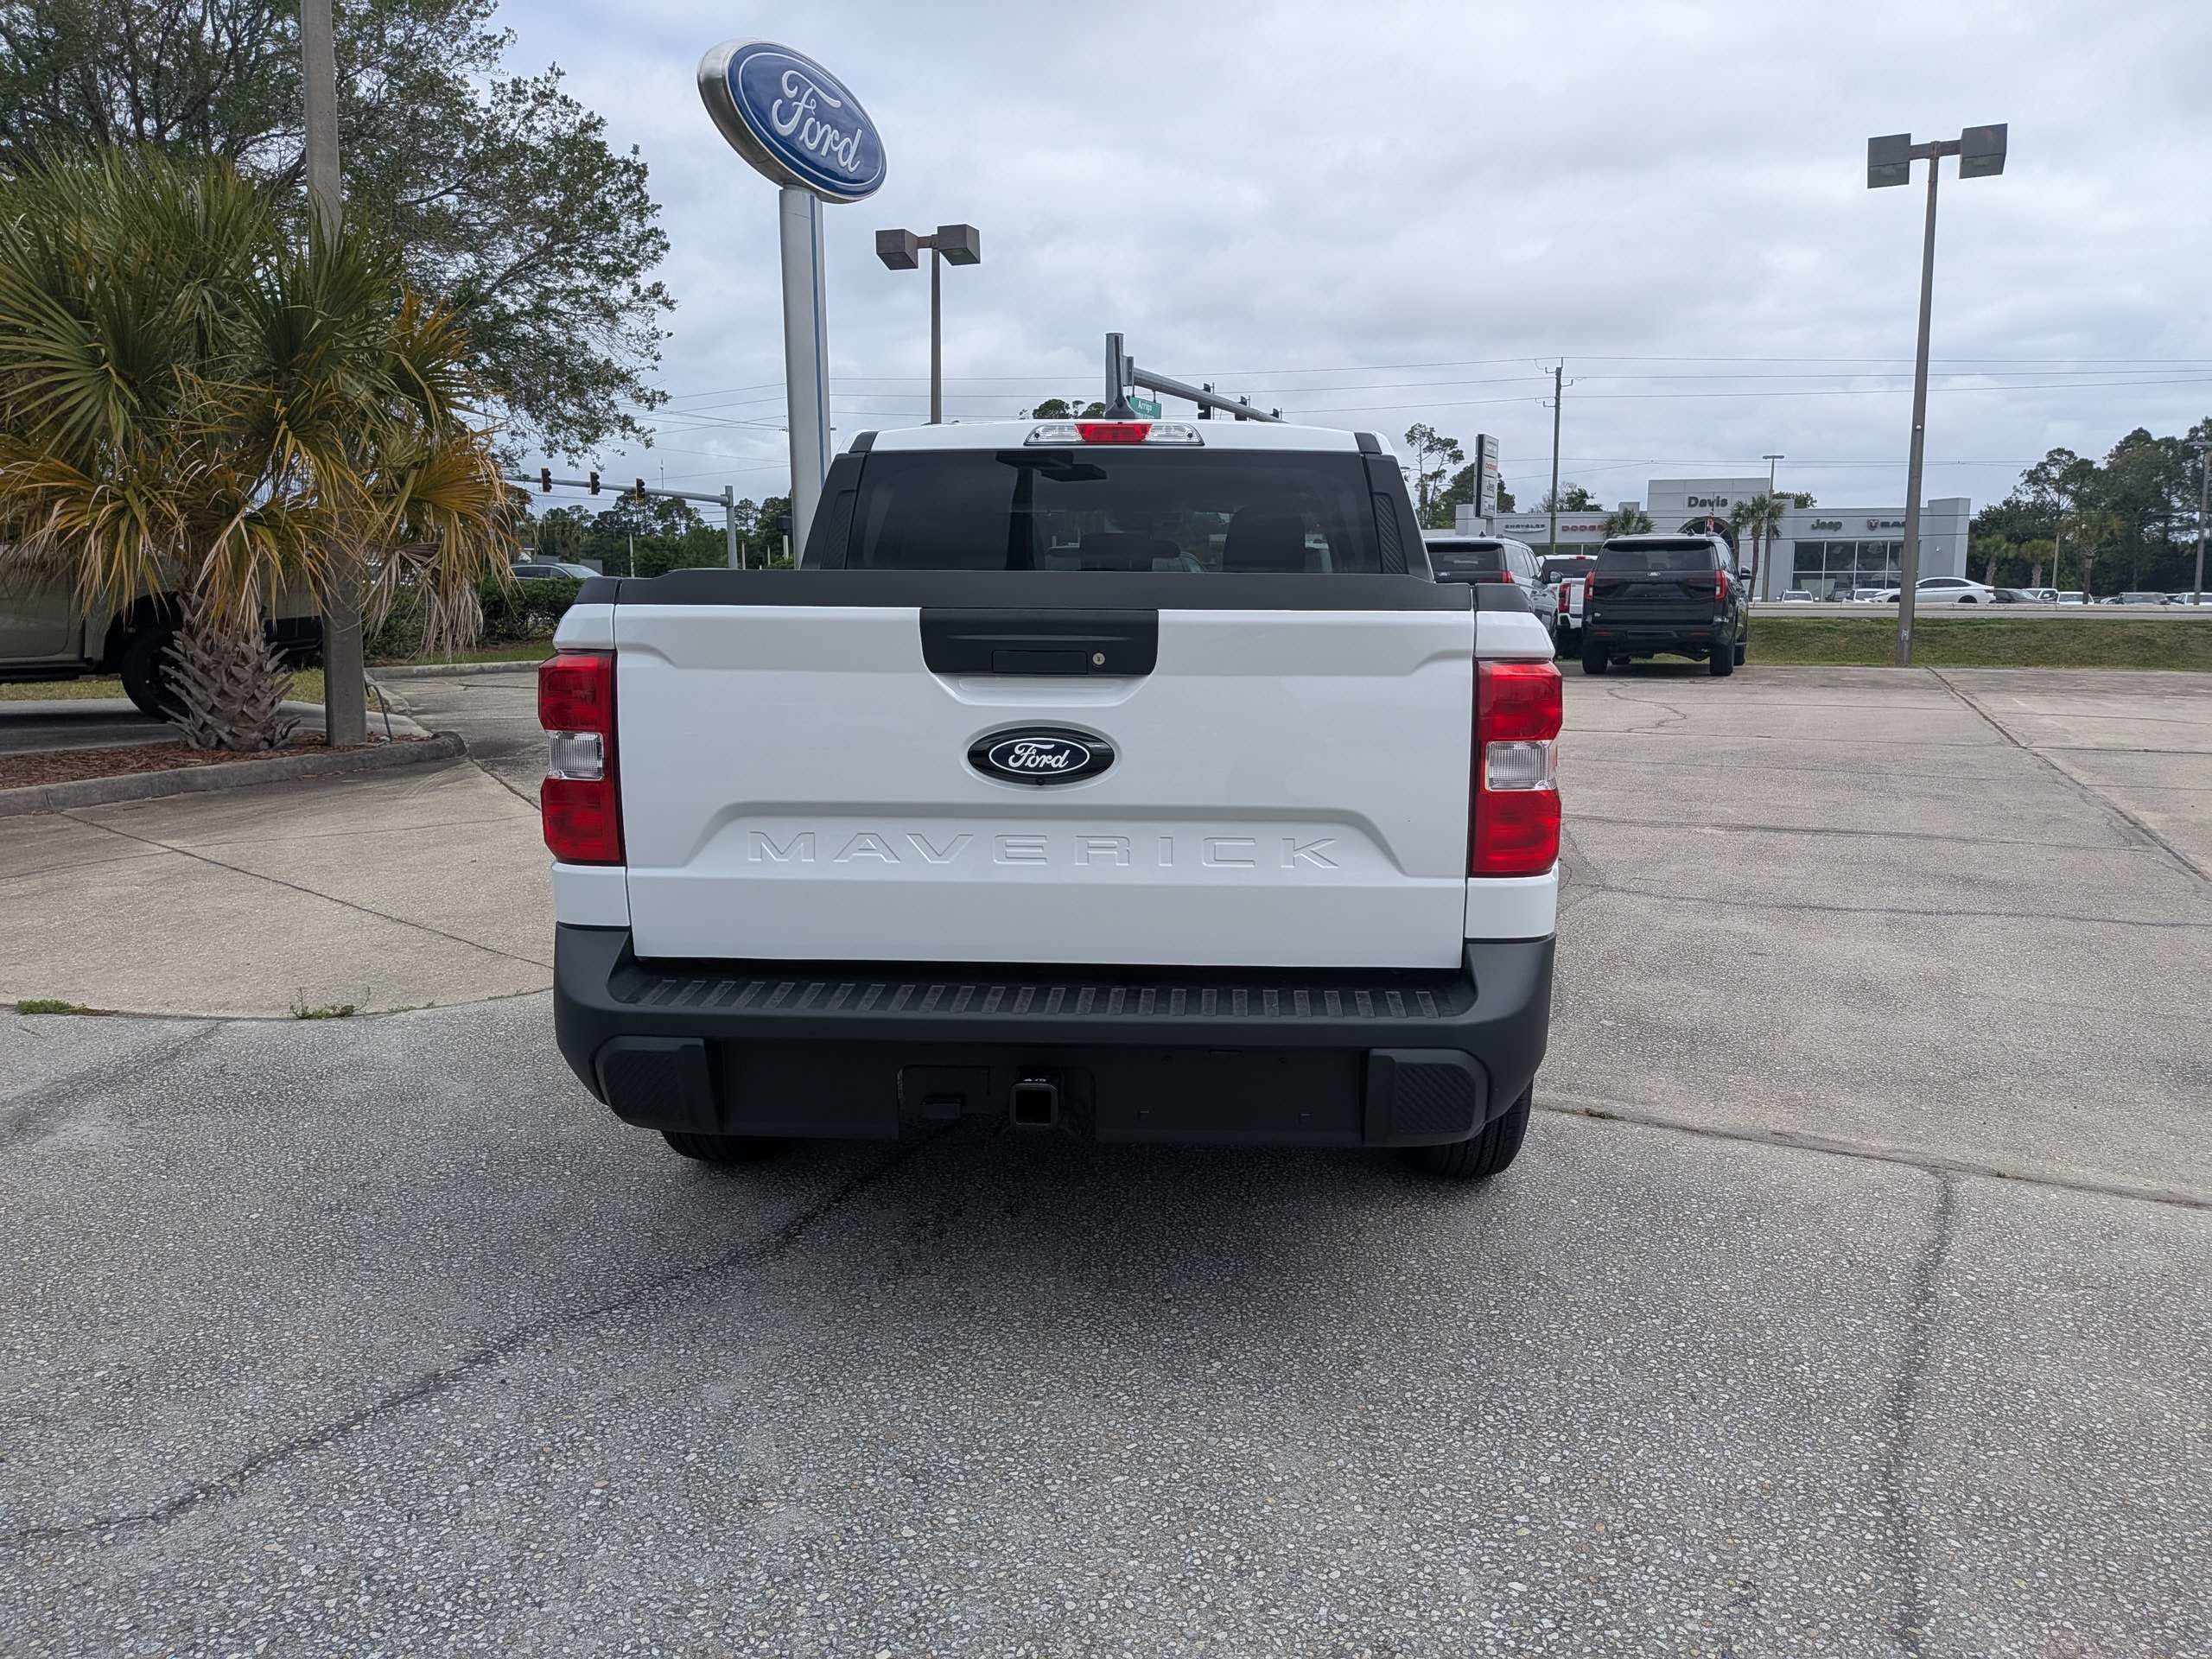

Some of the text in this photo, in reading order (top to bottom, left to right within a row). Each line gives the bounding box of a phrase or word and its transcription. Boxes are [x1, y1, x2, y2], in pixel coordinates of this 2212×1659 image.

[772, 70, 862, 173] Ford
[1688, 495, 1728, 508] Davis
[1811, 518, 1843, 532] Jeep
[1008, 742, 1071, 768] Ford
[748, 831, 1339, 868] MAVERICK
